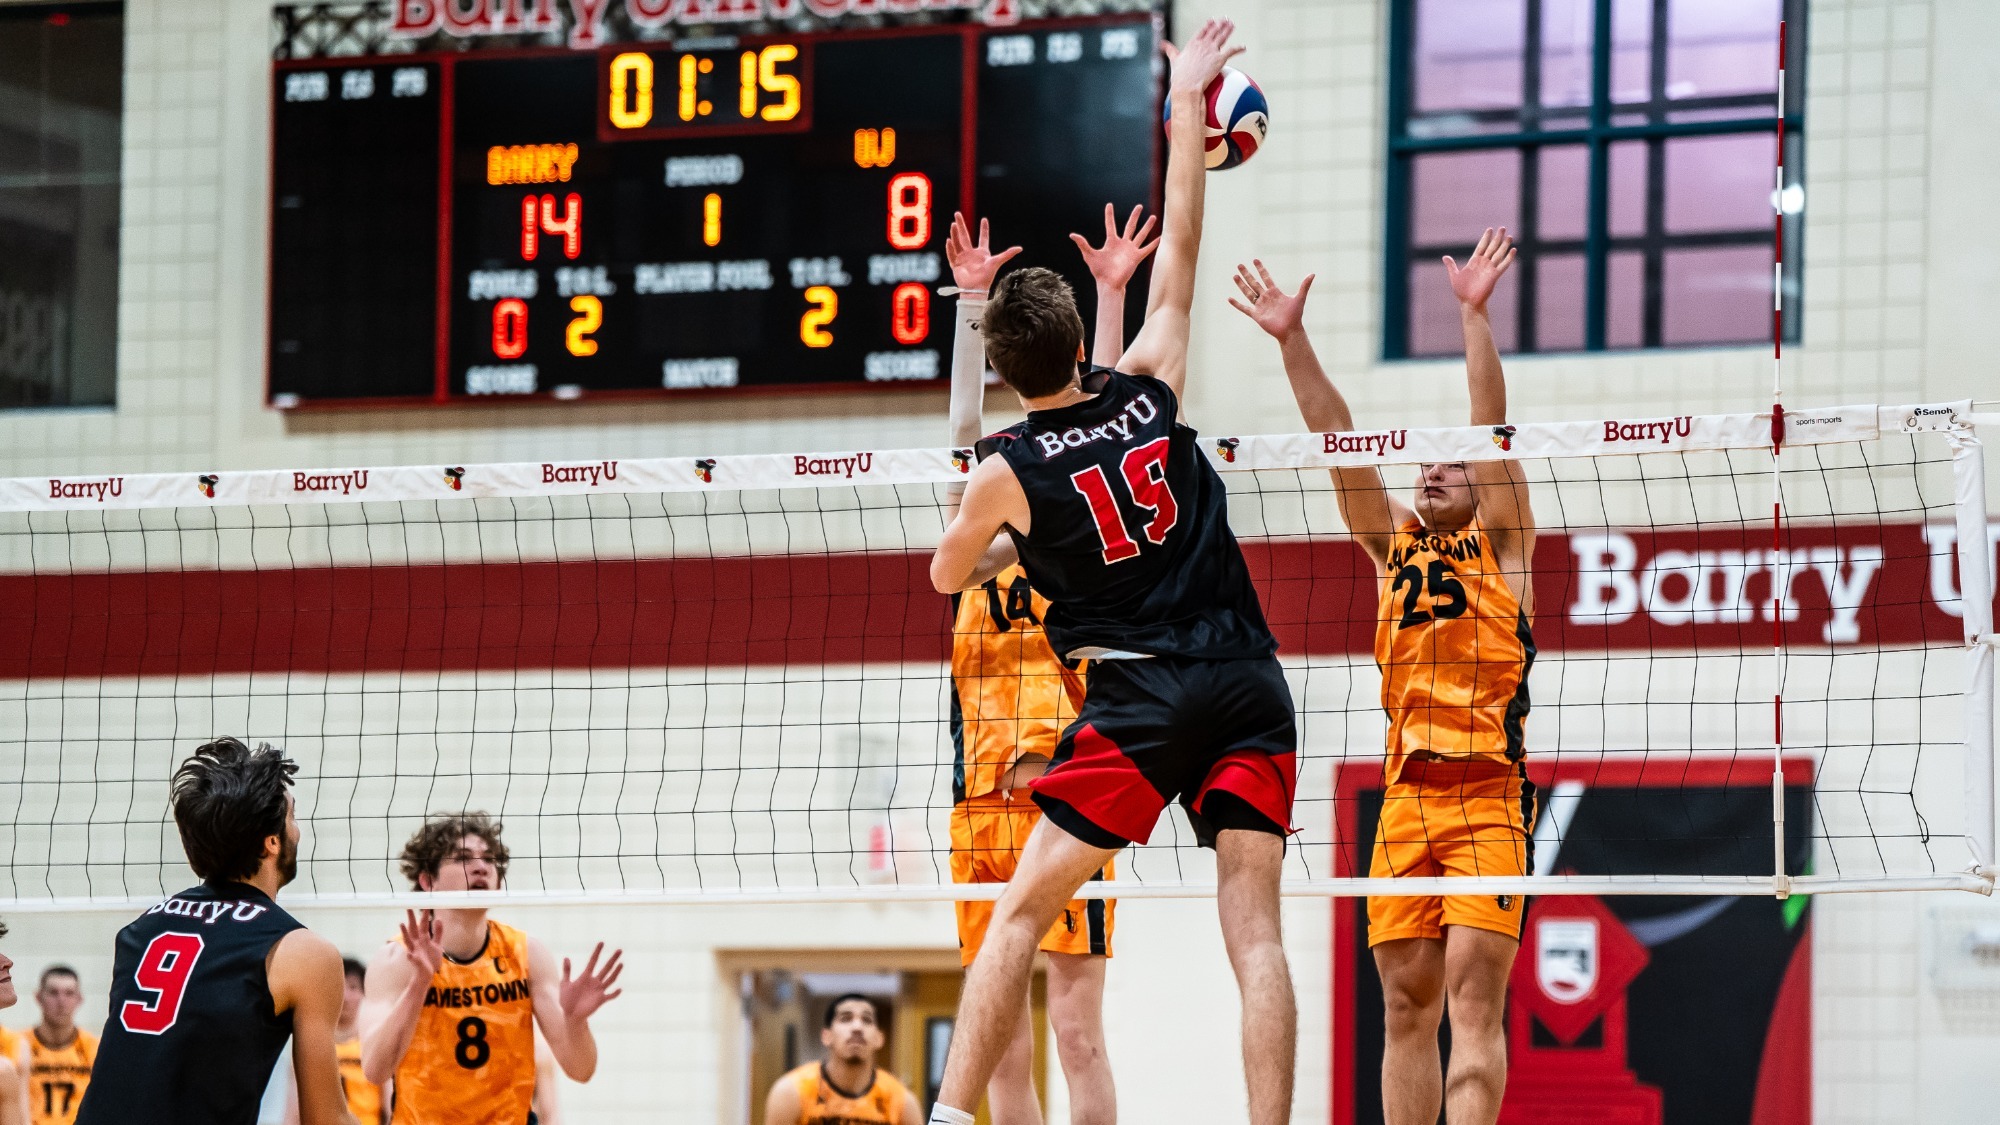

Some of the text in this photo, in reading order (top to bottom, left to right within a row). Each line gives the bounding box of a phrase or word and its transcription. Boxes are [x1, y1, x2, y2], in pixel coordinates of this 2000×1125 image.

[609, 44, 801, 129] 01:15
[487, 143, 579, 186] BARRY
[521, 192, 582, 260] 14
[704, 193, 722, 246] 1
[887, 172, 932, 250] 8
[492, 297, 528, 359] 0
[565, 294, 603, 357] 2
[800, 285, 838, 348] 2
[892, 281, 930, 345] 0
[1922, 407, 1953, 416] Senoh
[1069, 436, 1179, 566] 19
[981, 575, 1040, 633] 14
[1392, 560, 1468, 631] 25
[1569, 533, 1884, 644] Barry
[119, 930, 206, 1036] 9
[423, 979, 531, 1009] AMESTOWN
[455, 1016, 491, 1070] 8
[42, 1082, 76, 1117] 17
